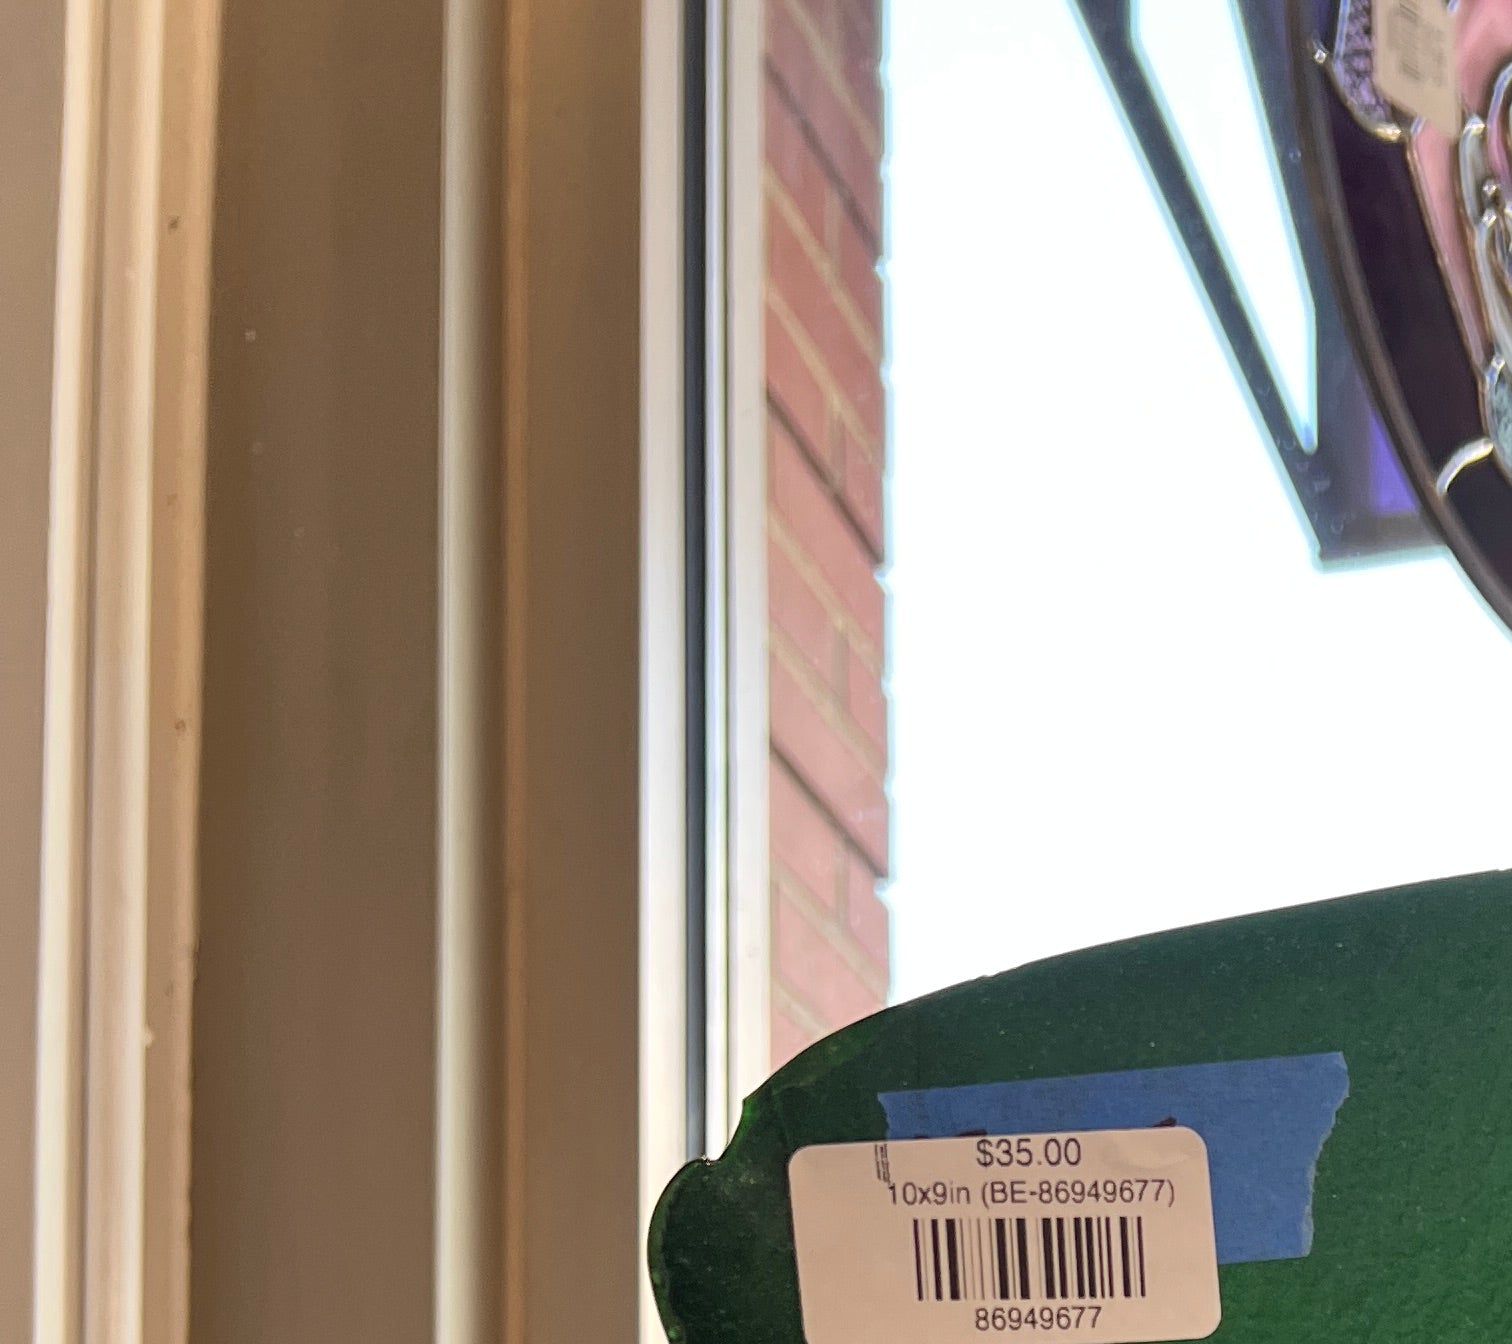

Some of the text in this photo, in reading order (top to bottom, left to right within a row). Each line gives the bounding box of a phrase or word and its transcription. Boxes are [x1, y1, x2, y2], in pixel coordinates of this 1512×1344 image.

[976, 1137, 1082, 1168] $35.00
[888, 1178, 1176, 1210] 10x9in (BE-86949677)
[975, 1306, 1102, 1332] 86949677
